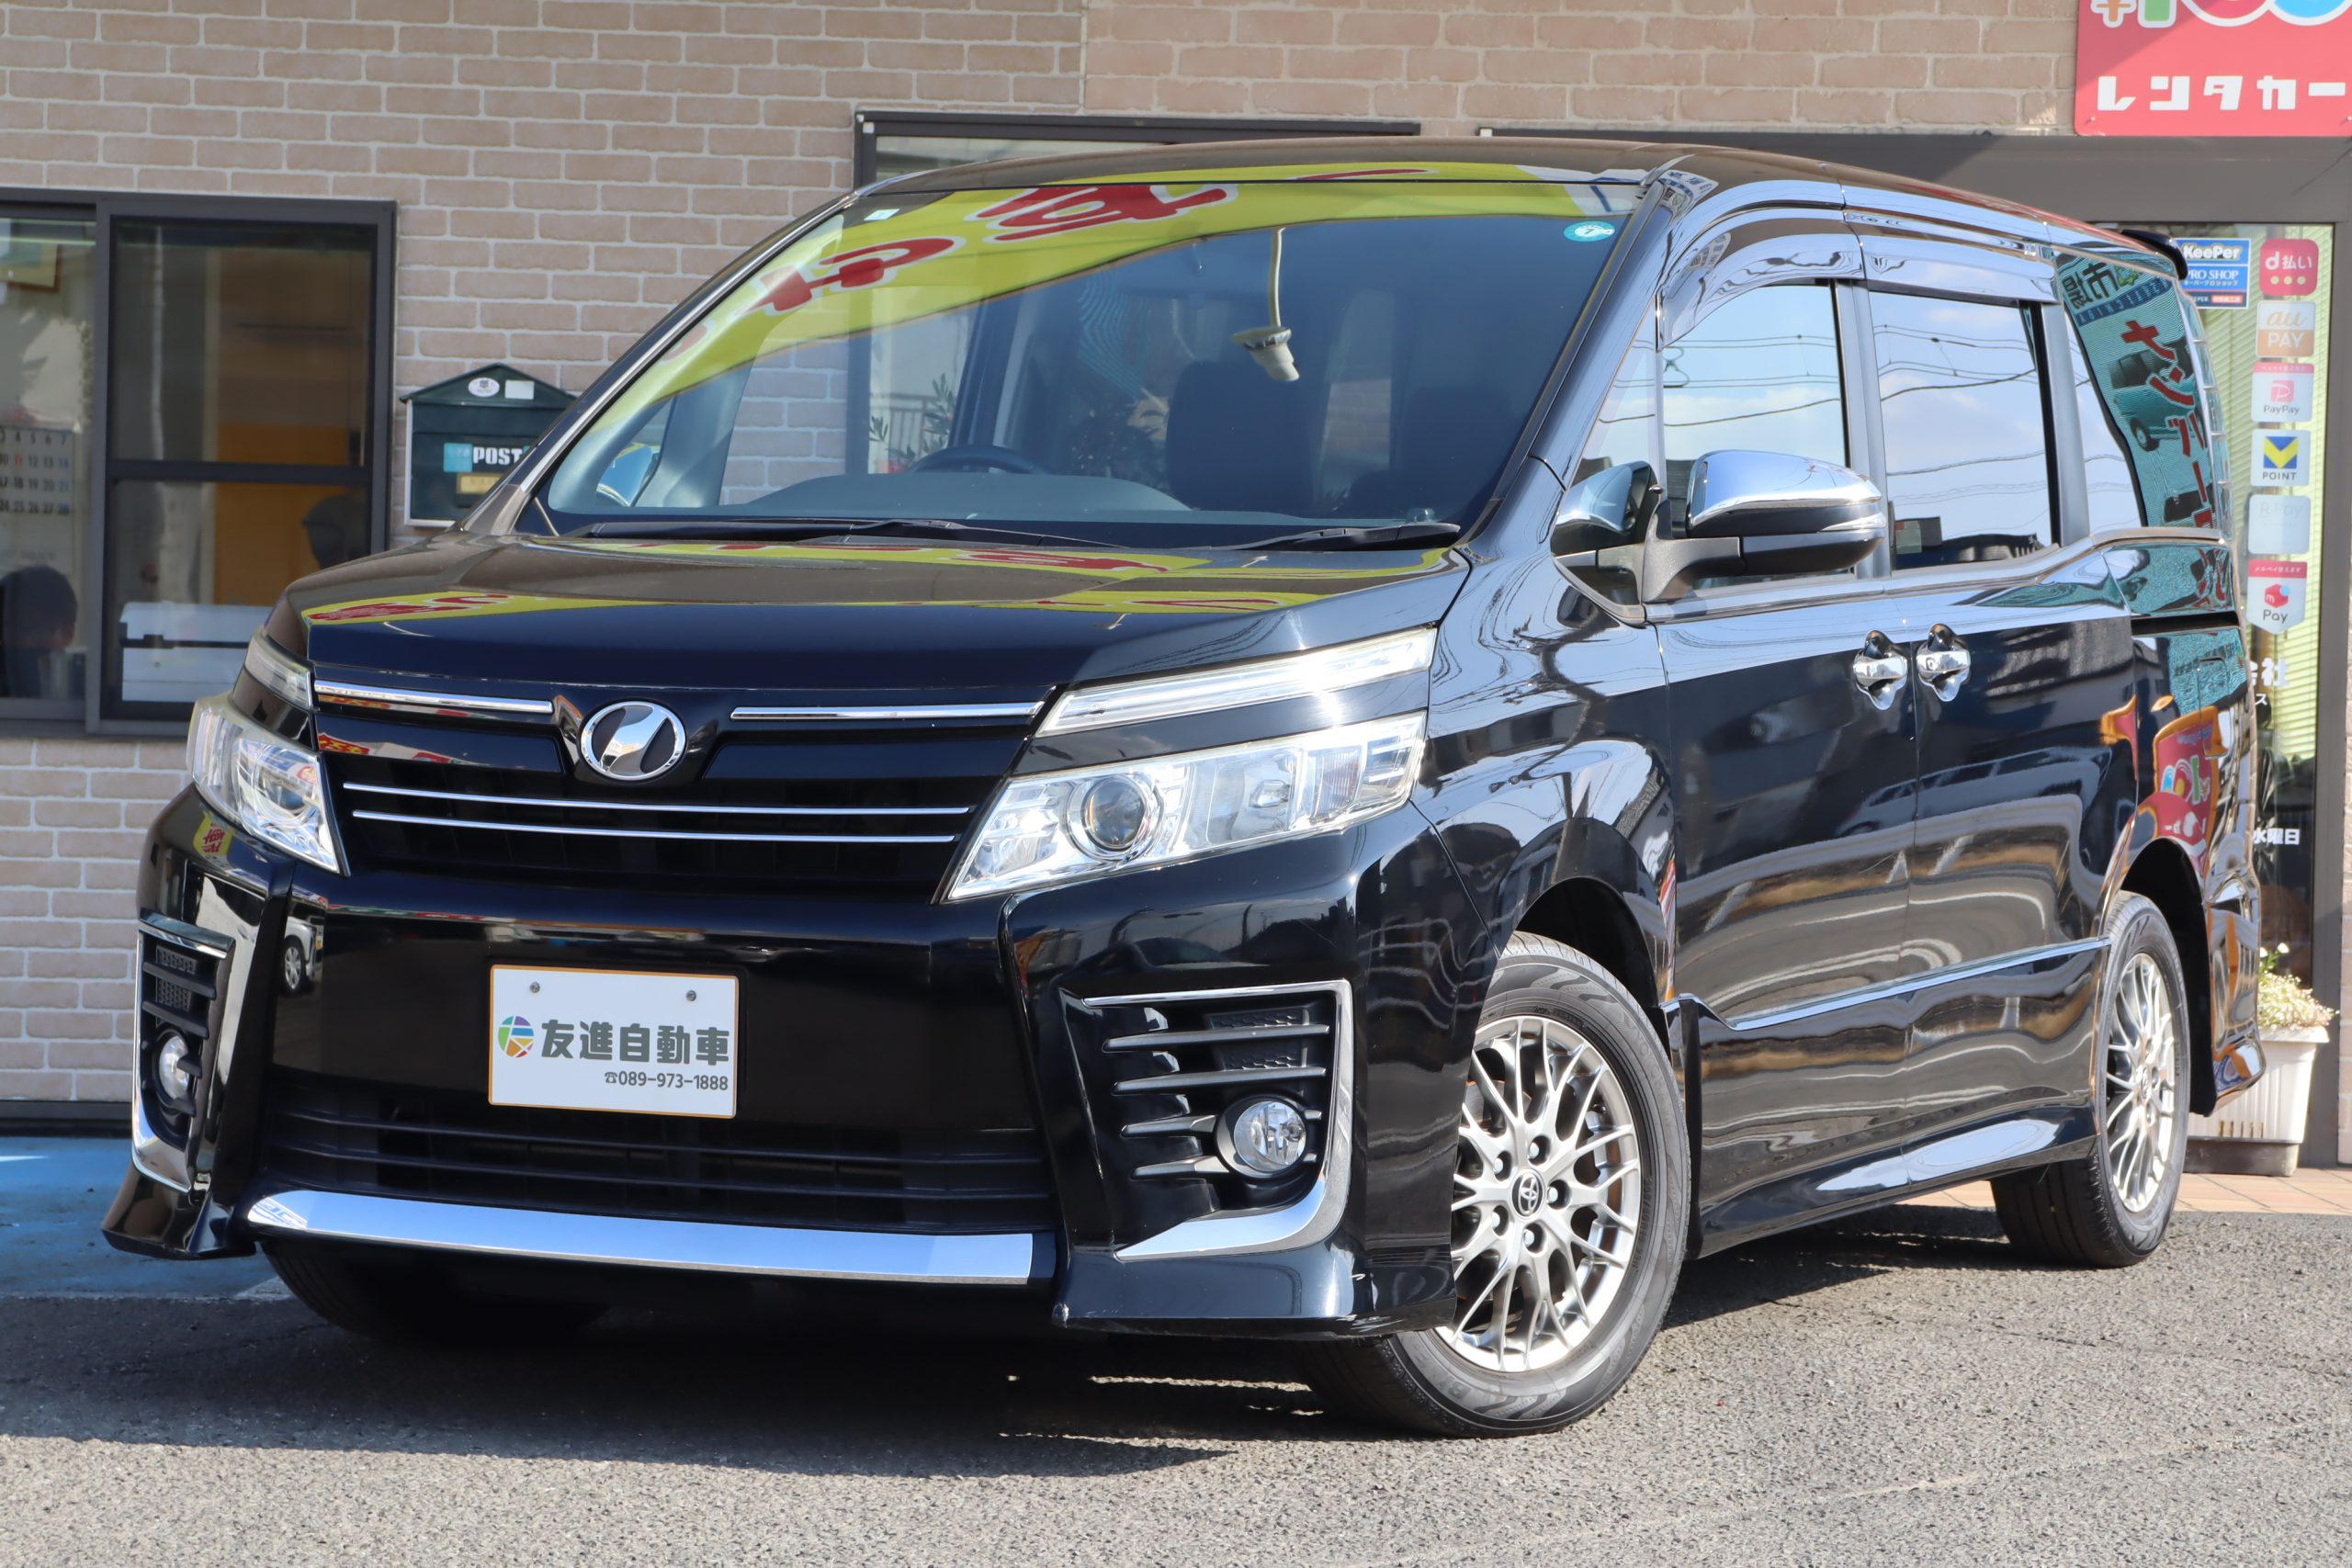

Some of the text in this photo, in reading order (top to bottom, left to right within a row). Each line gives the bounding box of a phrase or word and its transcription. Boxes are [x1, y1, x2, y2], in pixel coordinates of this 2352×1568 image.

[2097, 75, 2346, 111] レンタカー
[2183, 244, 2242, 261] KeePer
[2265, 251, 2312, 270] d払い
[2209, 270, 2239, 280] SHOP
[2266, 310, 2308, 326] au
[2267, 333, 2305, 348] PAY
[2264, 405, 2300, 415] PayPay
[473, 446, 524, 465] POST
[2262, 471, 2297, 480] POINT
[2263, 609, 2289, 624] Pay
[541, 1019, 730, 1066] 友進自動車
[618, 1071, 729, 1091] 089-973-1888
